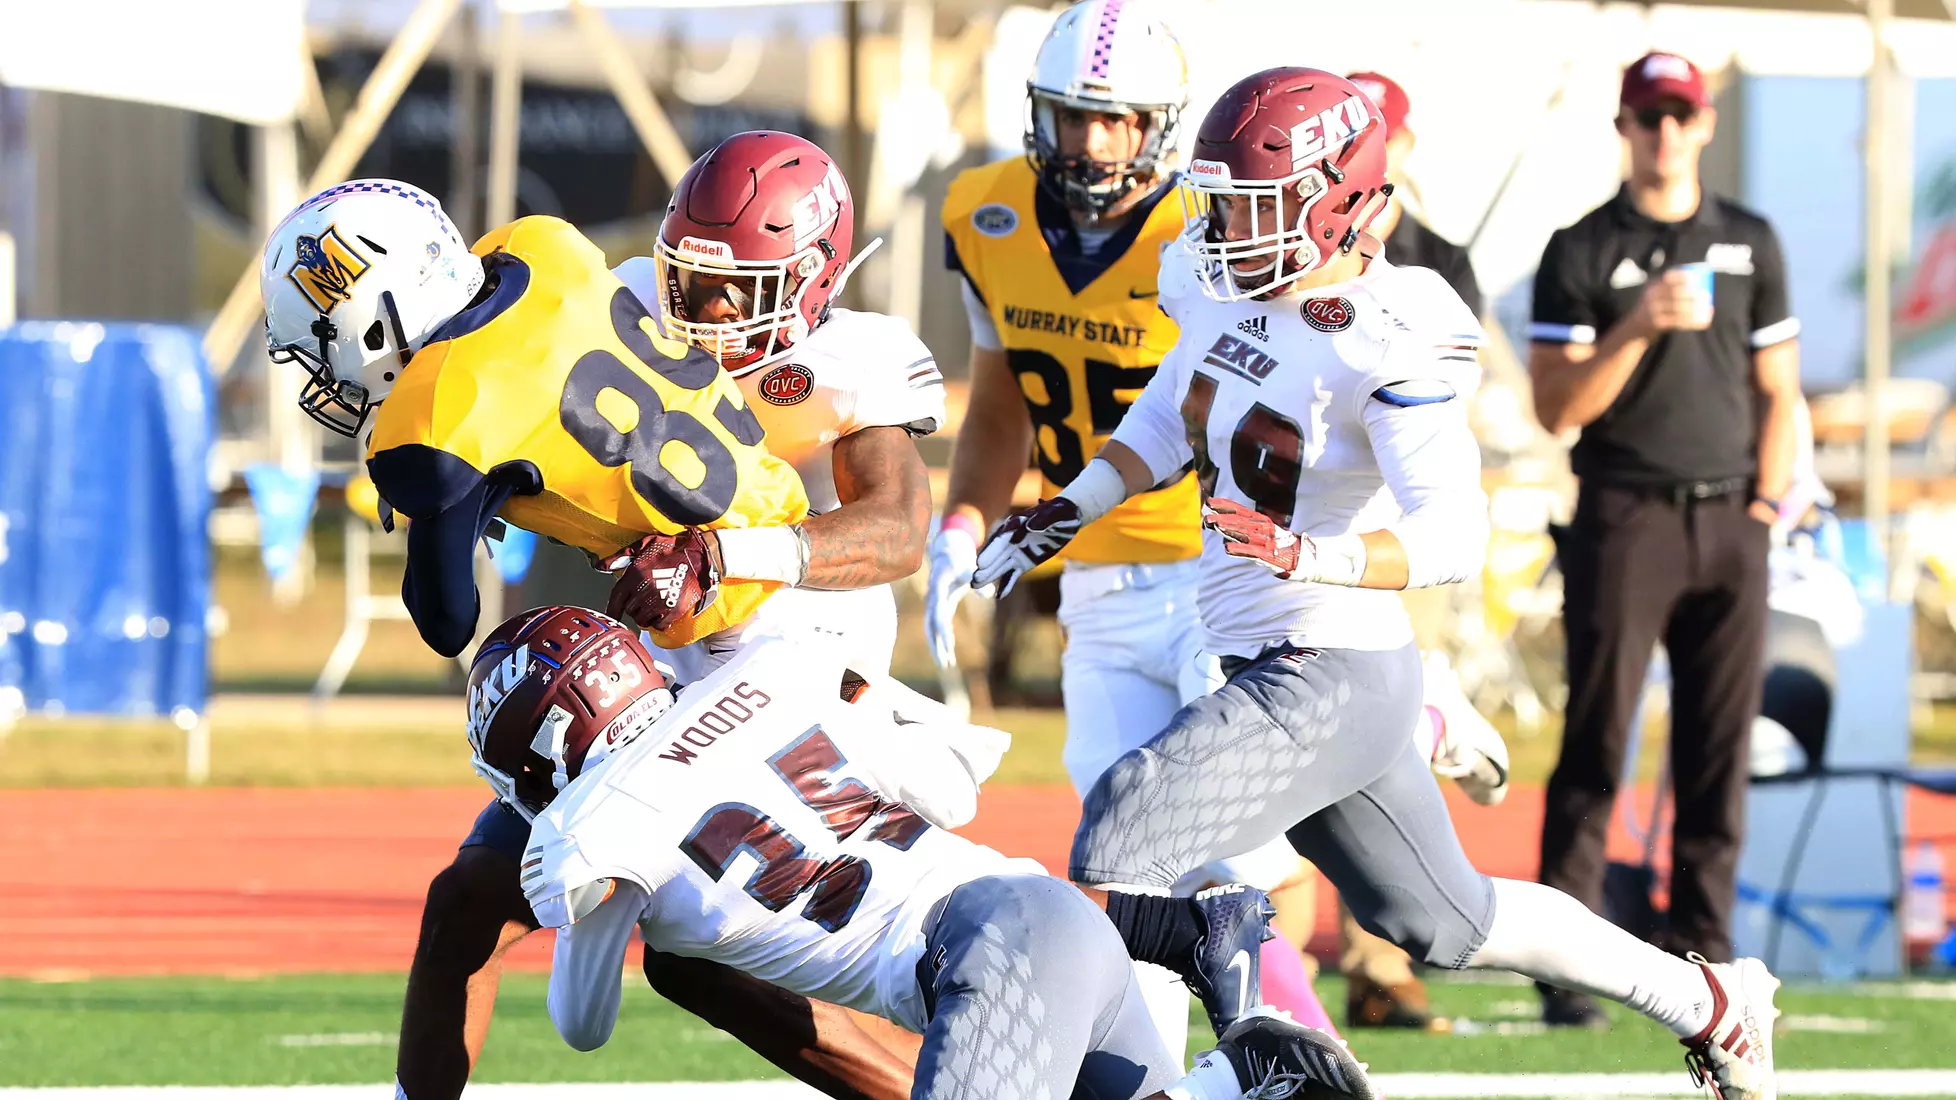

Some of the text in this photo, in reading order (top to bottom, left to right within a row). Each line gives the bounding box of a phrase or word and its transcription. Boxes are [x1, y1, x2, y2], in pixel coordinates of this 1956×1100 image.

[1290, 95, 1369, 162] EKU
[285, 222, 372, 315] M
[683, 239, 723, 257] Riddell
[1003, 303, 1147, 346] MURRAY STATE
[1237, 321, 1269, 343] adidas
[1311, 302, 1342, 321] OVC
[1207, 332, 1280, 380] EKU
[771, 376, 800, 394] OVC
[1004, 347, 1160, 490] 85
[665, 563, 689, 608] adidas
[584, 649, 642, 709] 35
[606, 696, 658, 746] COLONELS
[658, 681, 771, 766] WOODS
[678, 723, 932, 934] 35
